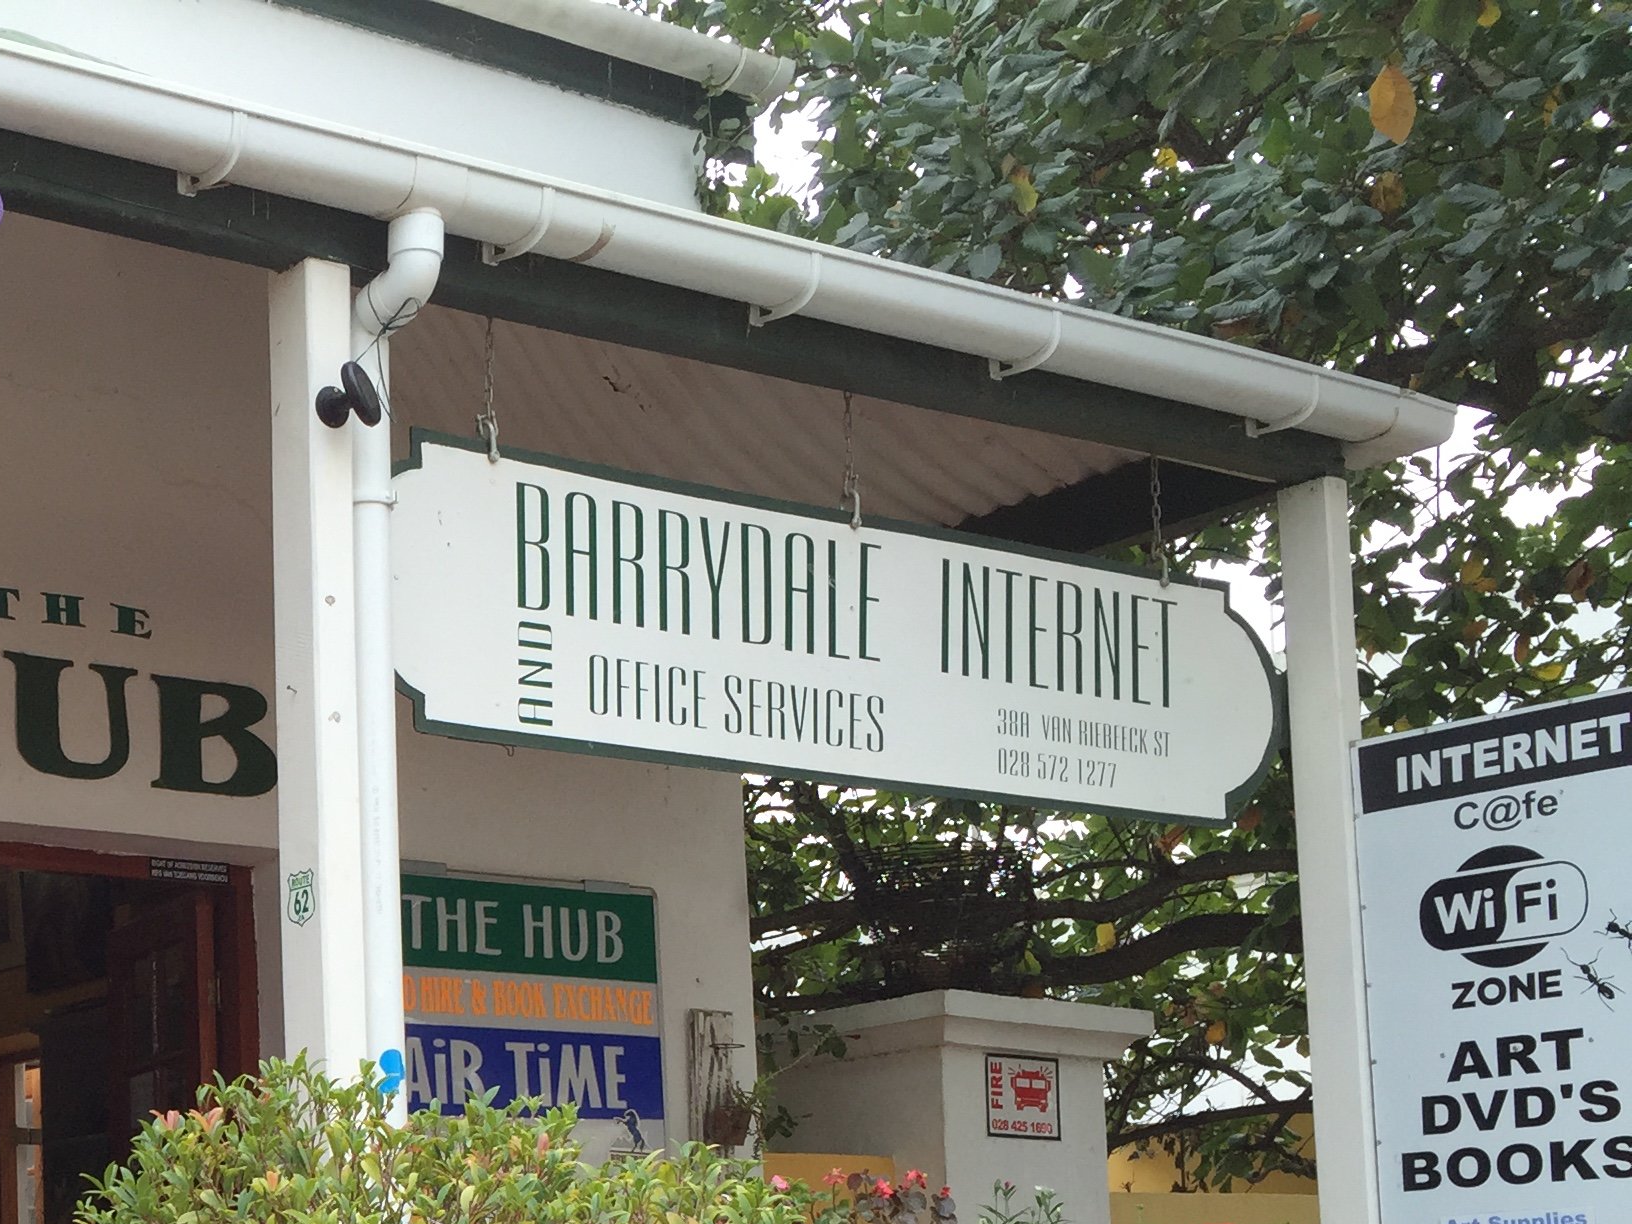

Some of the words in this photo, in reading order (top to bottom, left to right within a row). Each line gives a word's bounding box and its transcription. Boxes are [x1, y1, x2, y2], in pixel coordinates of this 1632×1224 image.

[515, 481, 882, 662] BARRYDALE
[941, 558, 1178, 708] INTERNET
[517, 621, 553, 727] AND
[589, 654, 707, 729] OFFICE
[724, 674, 885, 753] SERVICES
[997, 708, 1030, 738] 38A
[1042, 714, 1072, 744] VAN
[1078, 719, 1148, 754] RIEBEECK
[1154, 730, 1171, 757] ST
[1395, 712, 1631, 793] INTERNET
[998, 748, 1030, 778] 028
[1037, 753, 1068, 783] 572
[1078, 758, 1117, 788] 1277
[1454, 790, 1558, 831] C@fe
[294, 889, 310, 916] 62
[402, 894, 502, 955] THE
[523, 903, 624, 963] HUB
[1433, 879, 1558, 934] WiFi
[419, 975, 465, 1016] HIRE
[470, 979, 487, 1017] &
[492, 979, 547, 1020] BOOK
[553, 982, 654, 1026] EXCHANGE
[1451, 969, 1563, 1010] ZONE
[1447, 1028, 1584, 1082] ART
[990, 1061, 1003, 1110] FIRE
[1421, 1080, 1622, 1136] DVD'S
[1401, 1136, 1632, 1192] BOOKS
